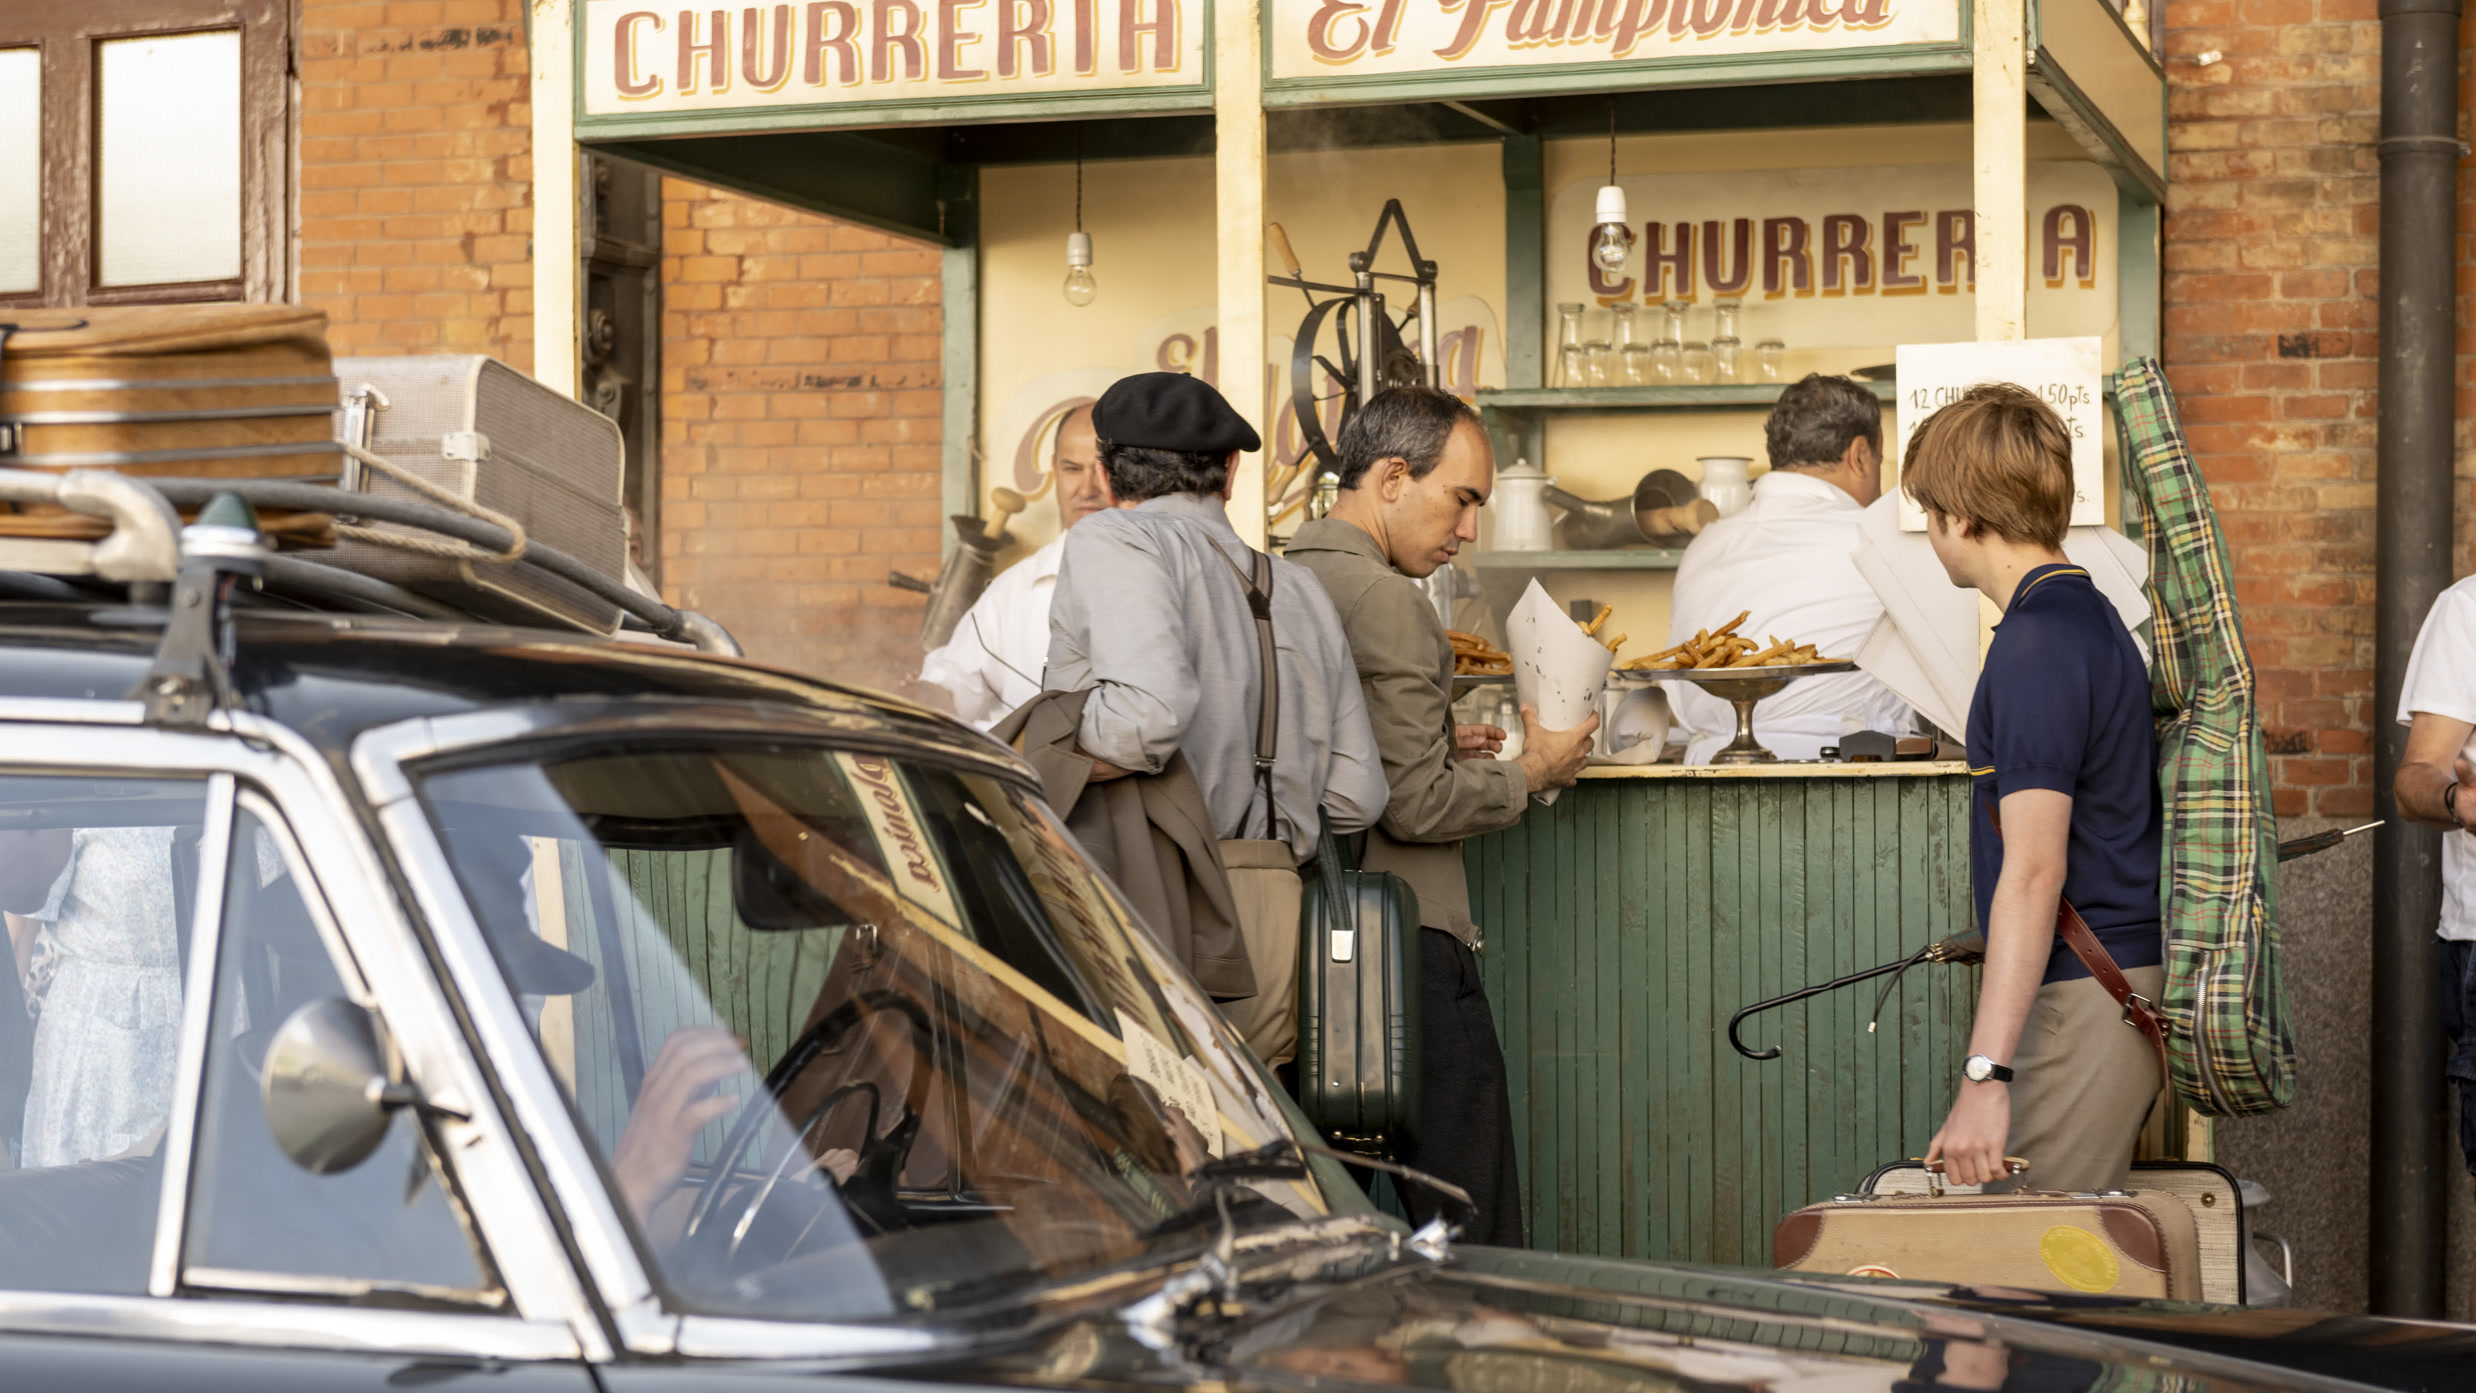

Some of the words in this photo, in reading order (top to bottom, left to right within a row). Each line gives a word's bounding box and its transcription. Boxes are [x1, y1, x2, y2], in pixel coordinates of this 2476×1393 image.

[614, 0, 1178, 101] CHURRERIA
[1587, 204, 2096, 307] CHURRERA
[1908, 388, 1931, 409] 12
